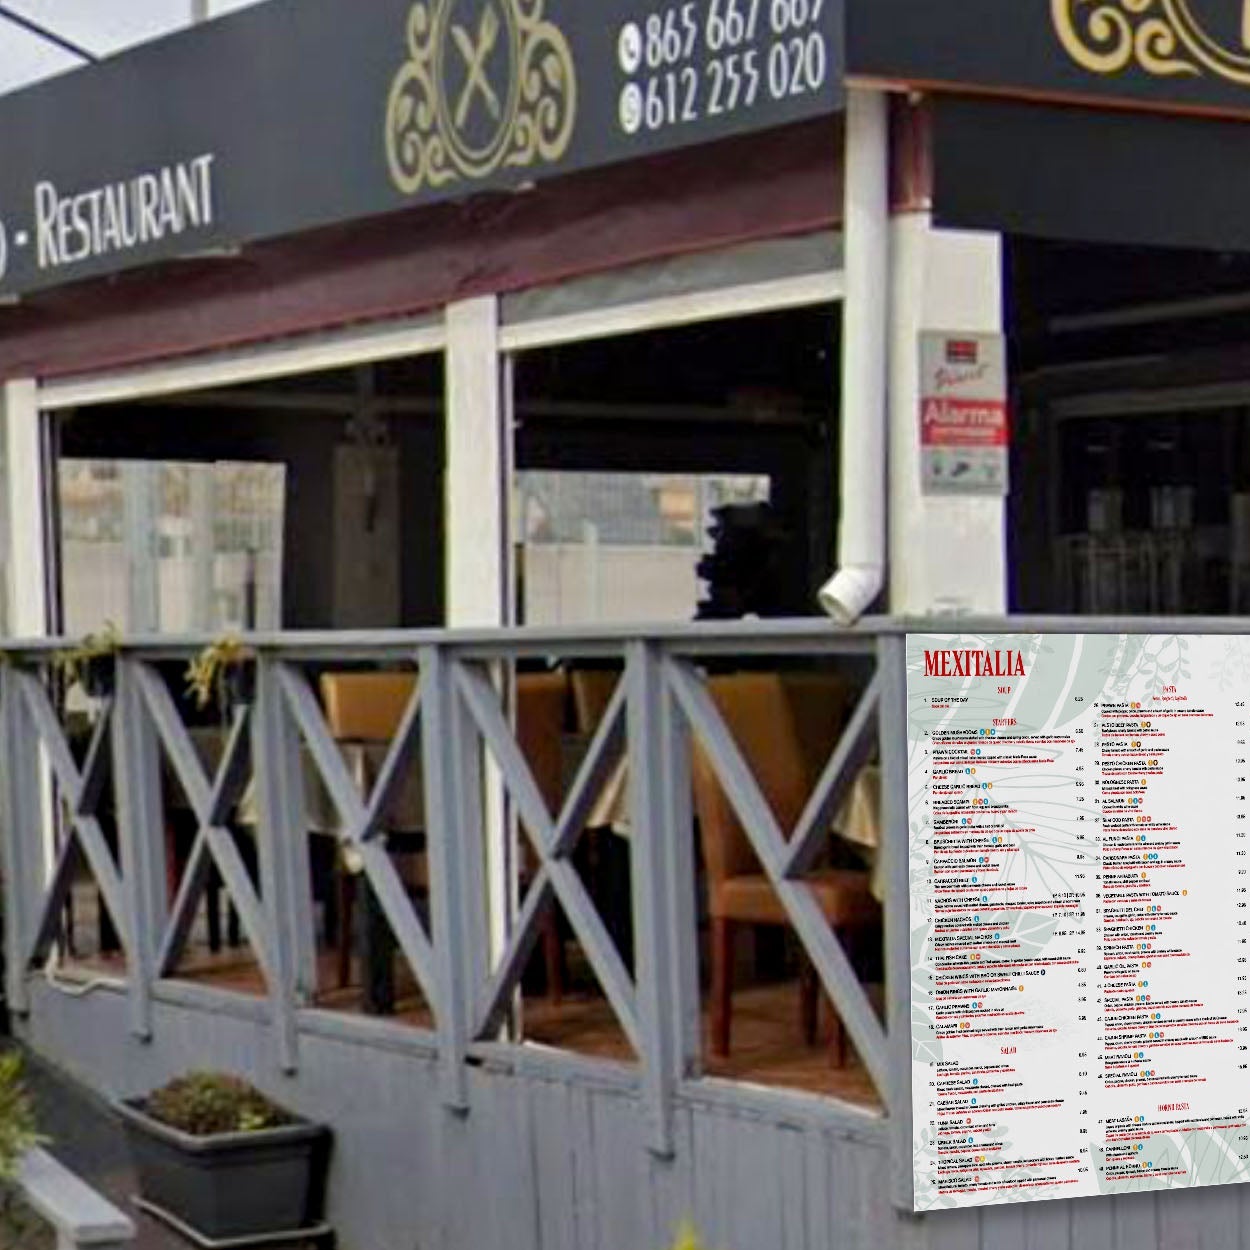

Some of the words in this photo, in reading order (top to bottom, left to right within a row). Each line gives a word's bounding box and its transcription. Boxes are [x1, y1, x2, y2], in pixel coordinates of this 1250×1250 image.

[646, 3, 698, 67] 865
[645, 67, 698, 129] 612
[706, 51, 759, 113] 255
[768, 32, 826, 98] 020
[34, 153, 215, 269] RESTAURANT
[924, 650, 1026, 677] MEXITALIA
